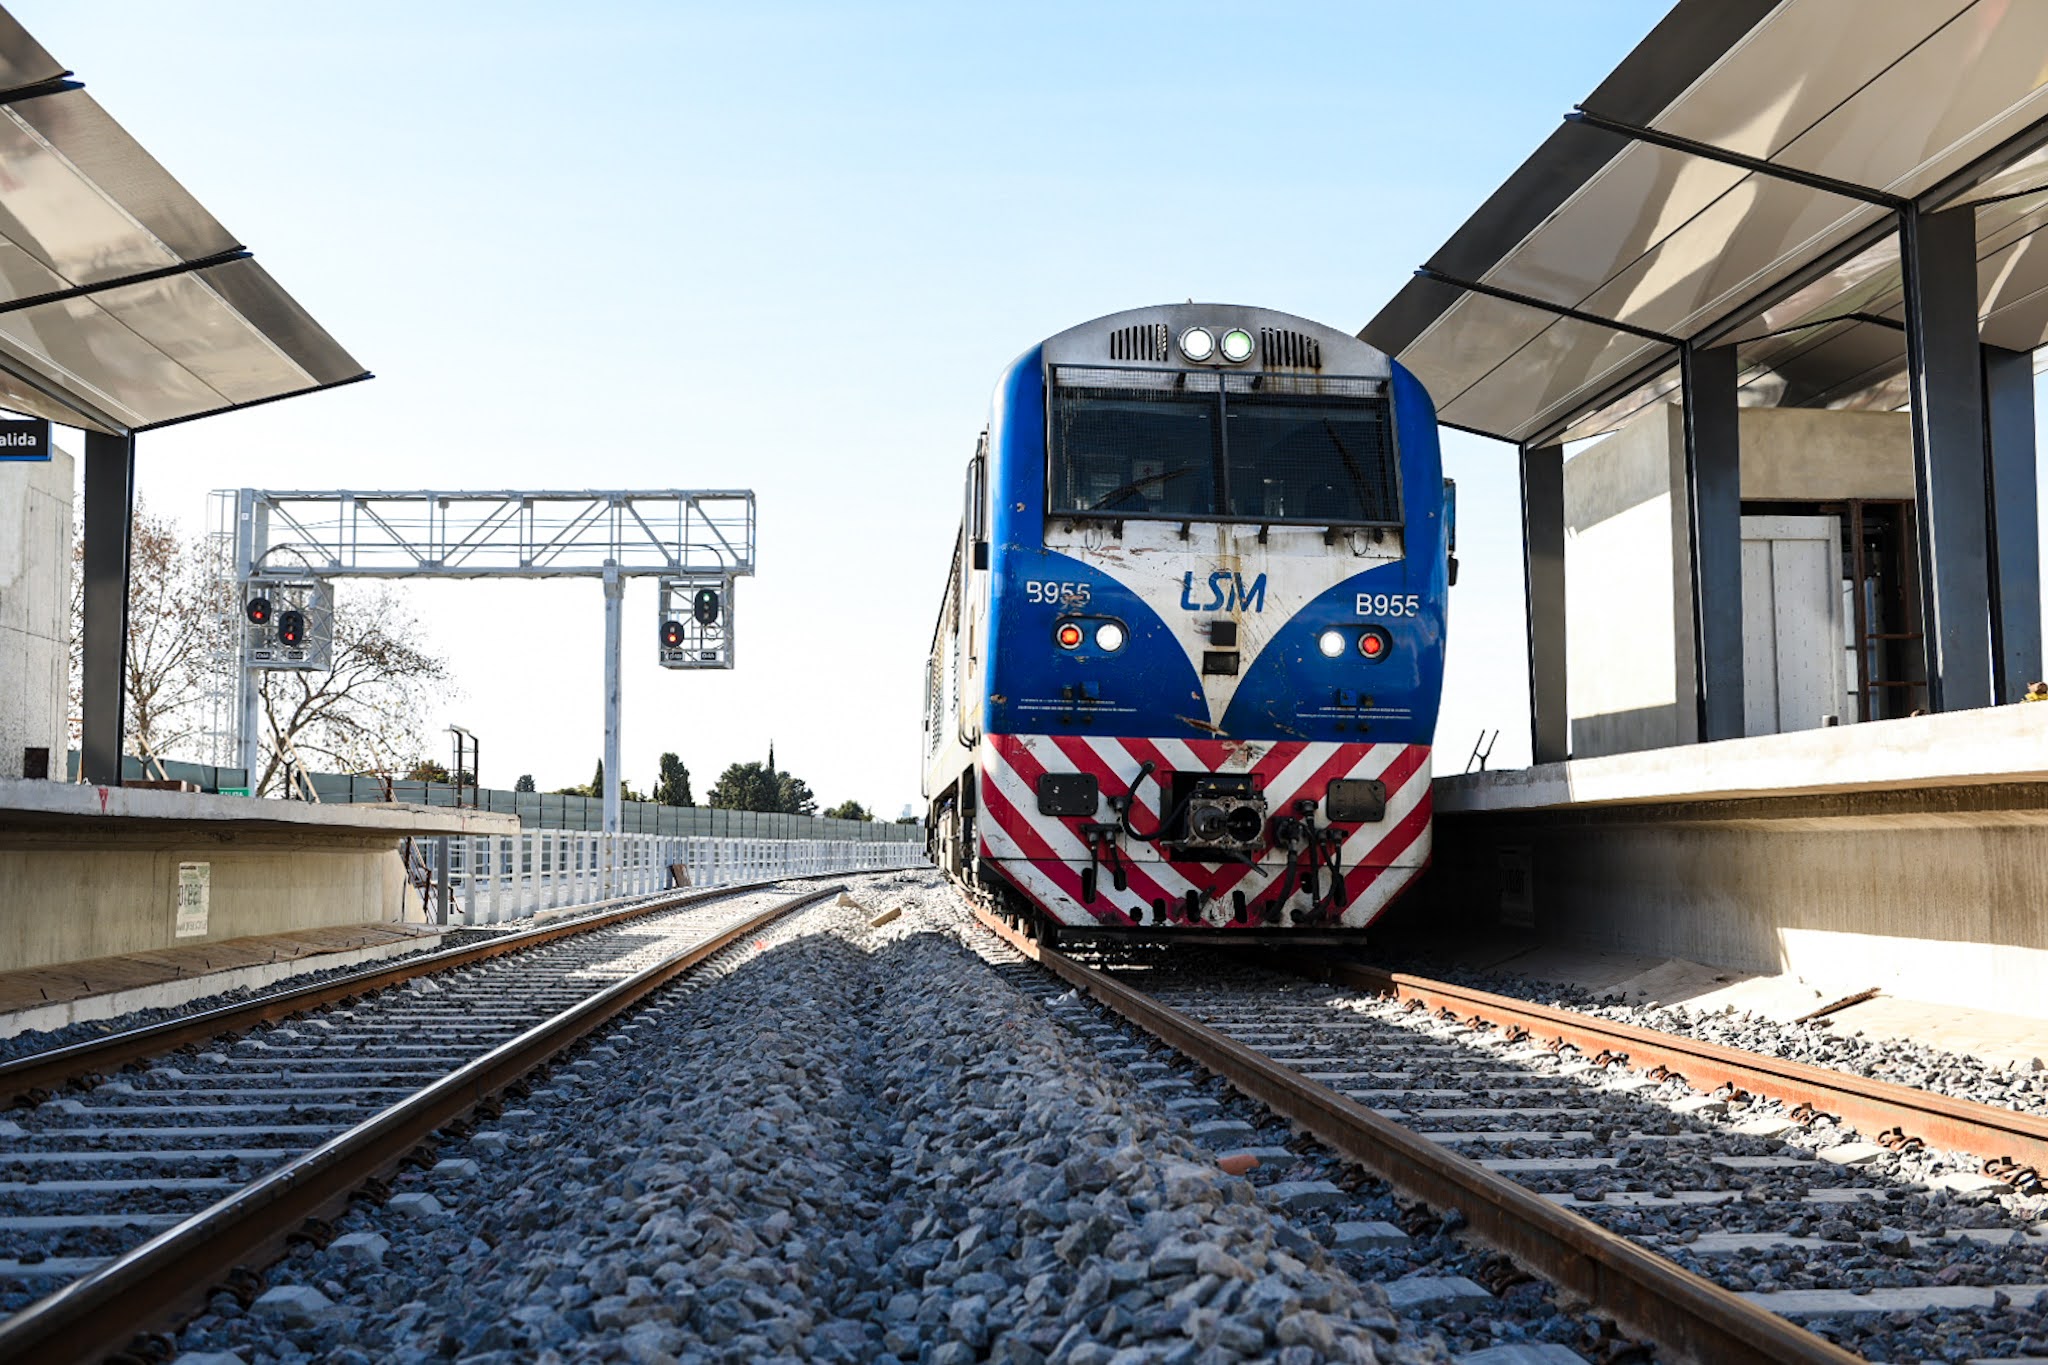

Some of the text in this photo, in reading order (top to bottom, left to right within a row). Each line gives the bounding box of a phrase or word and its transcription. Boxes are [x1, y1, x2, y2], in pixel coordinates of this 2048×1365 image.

[1026, 581, 1091, 605] B955
[1180, 571, 1267, 612] LSM
[1356, 593, 1419, 617] B955
